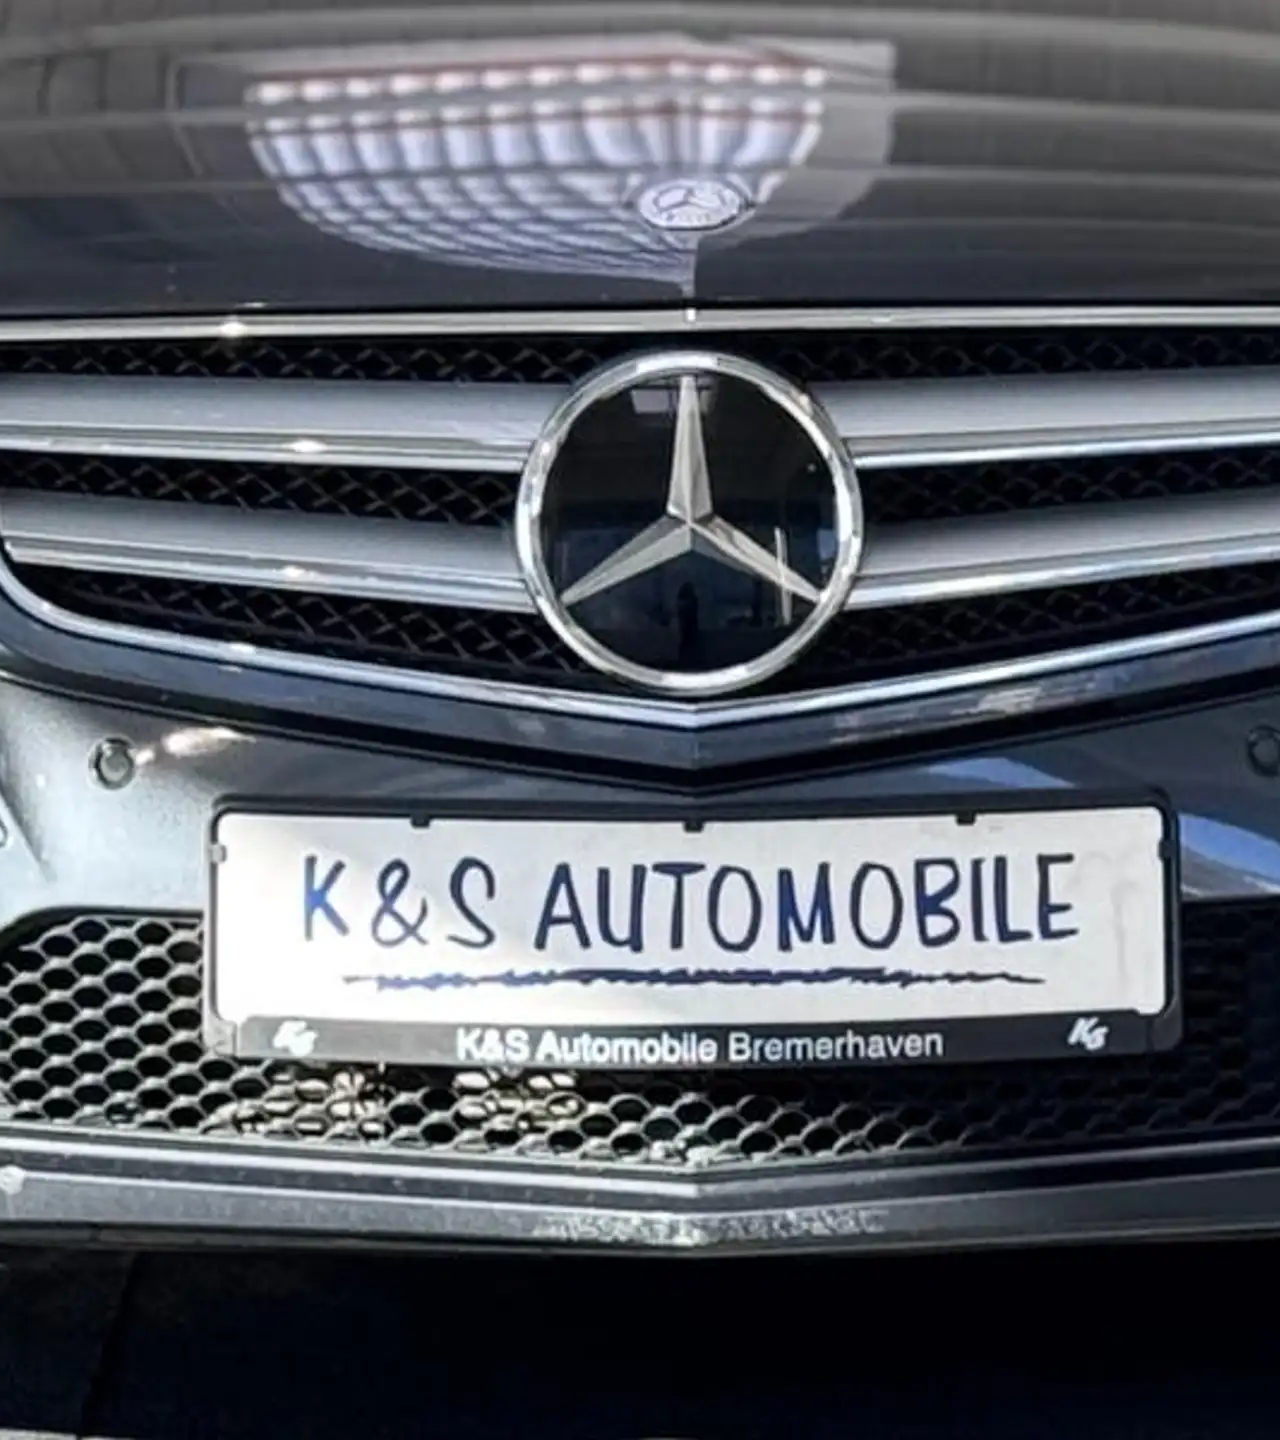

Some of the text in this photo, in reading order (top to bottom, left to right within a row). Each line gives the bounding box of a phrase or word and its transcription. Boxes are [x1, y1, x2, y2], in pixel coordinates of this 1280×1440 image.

[533, 853, 1079, 953] AUTOMOBILE
[456, 1027, 944, 1064] K&S Automobile Bremerhaven
